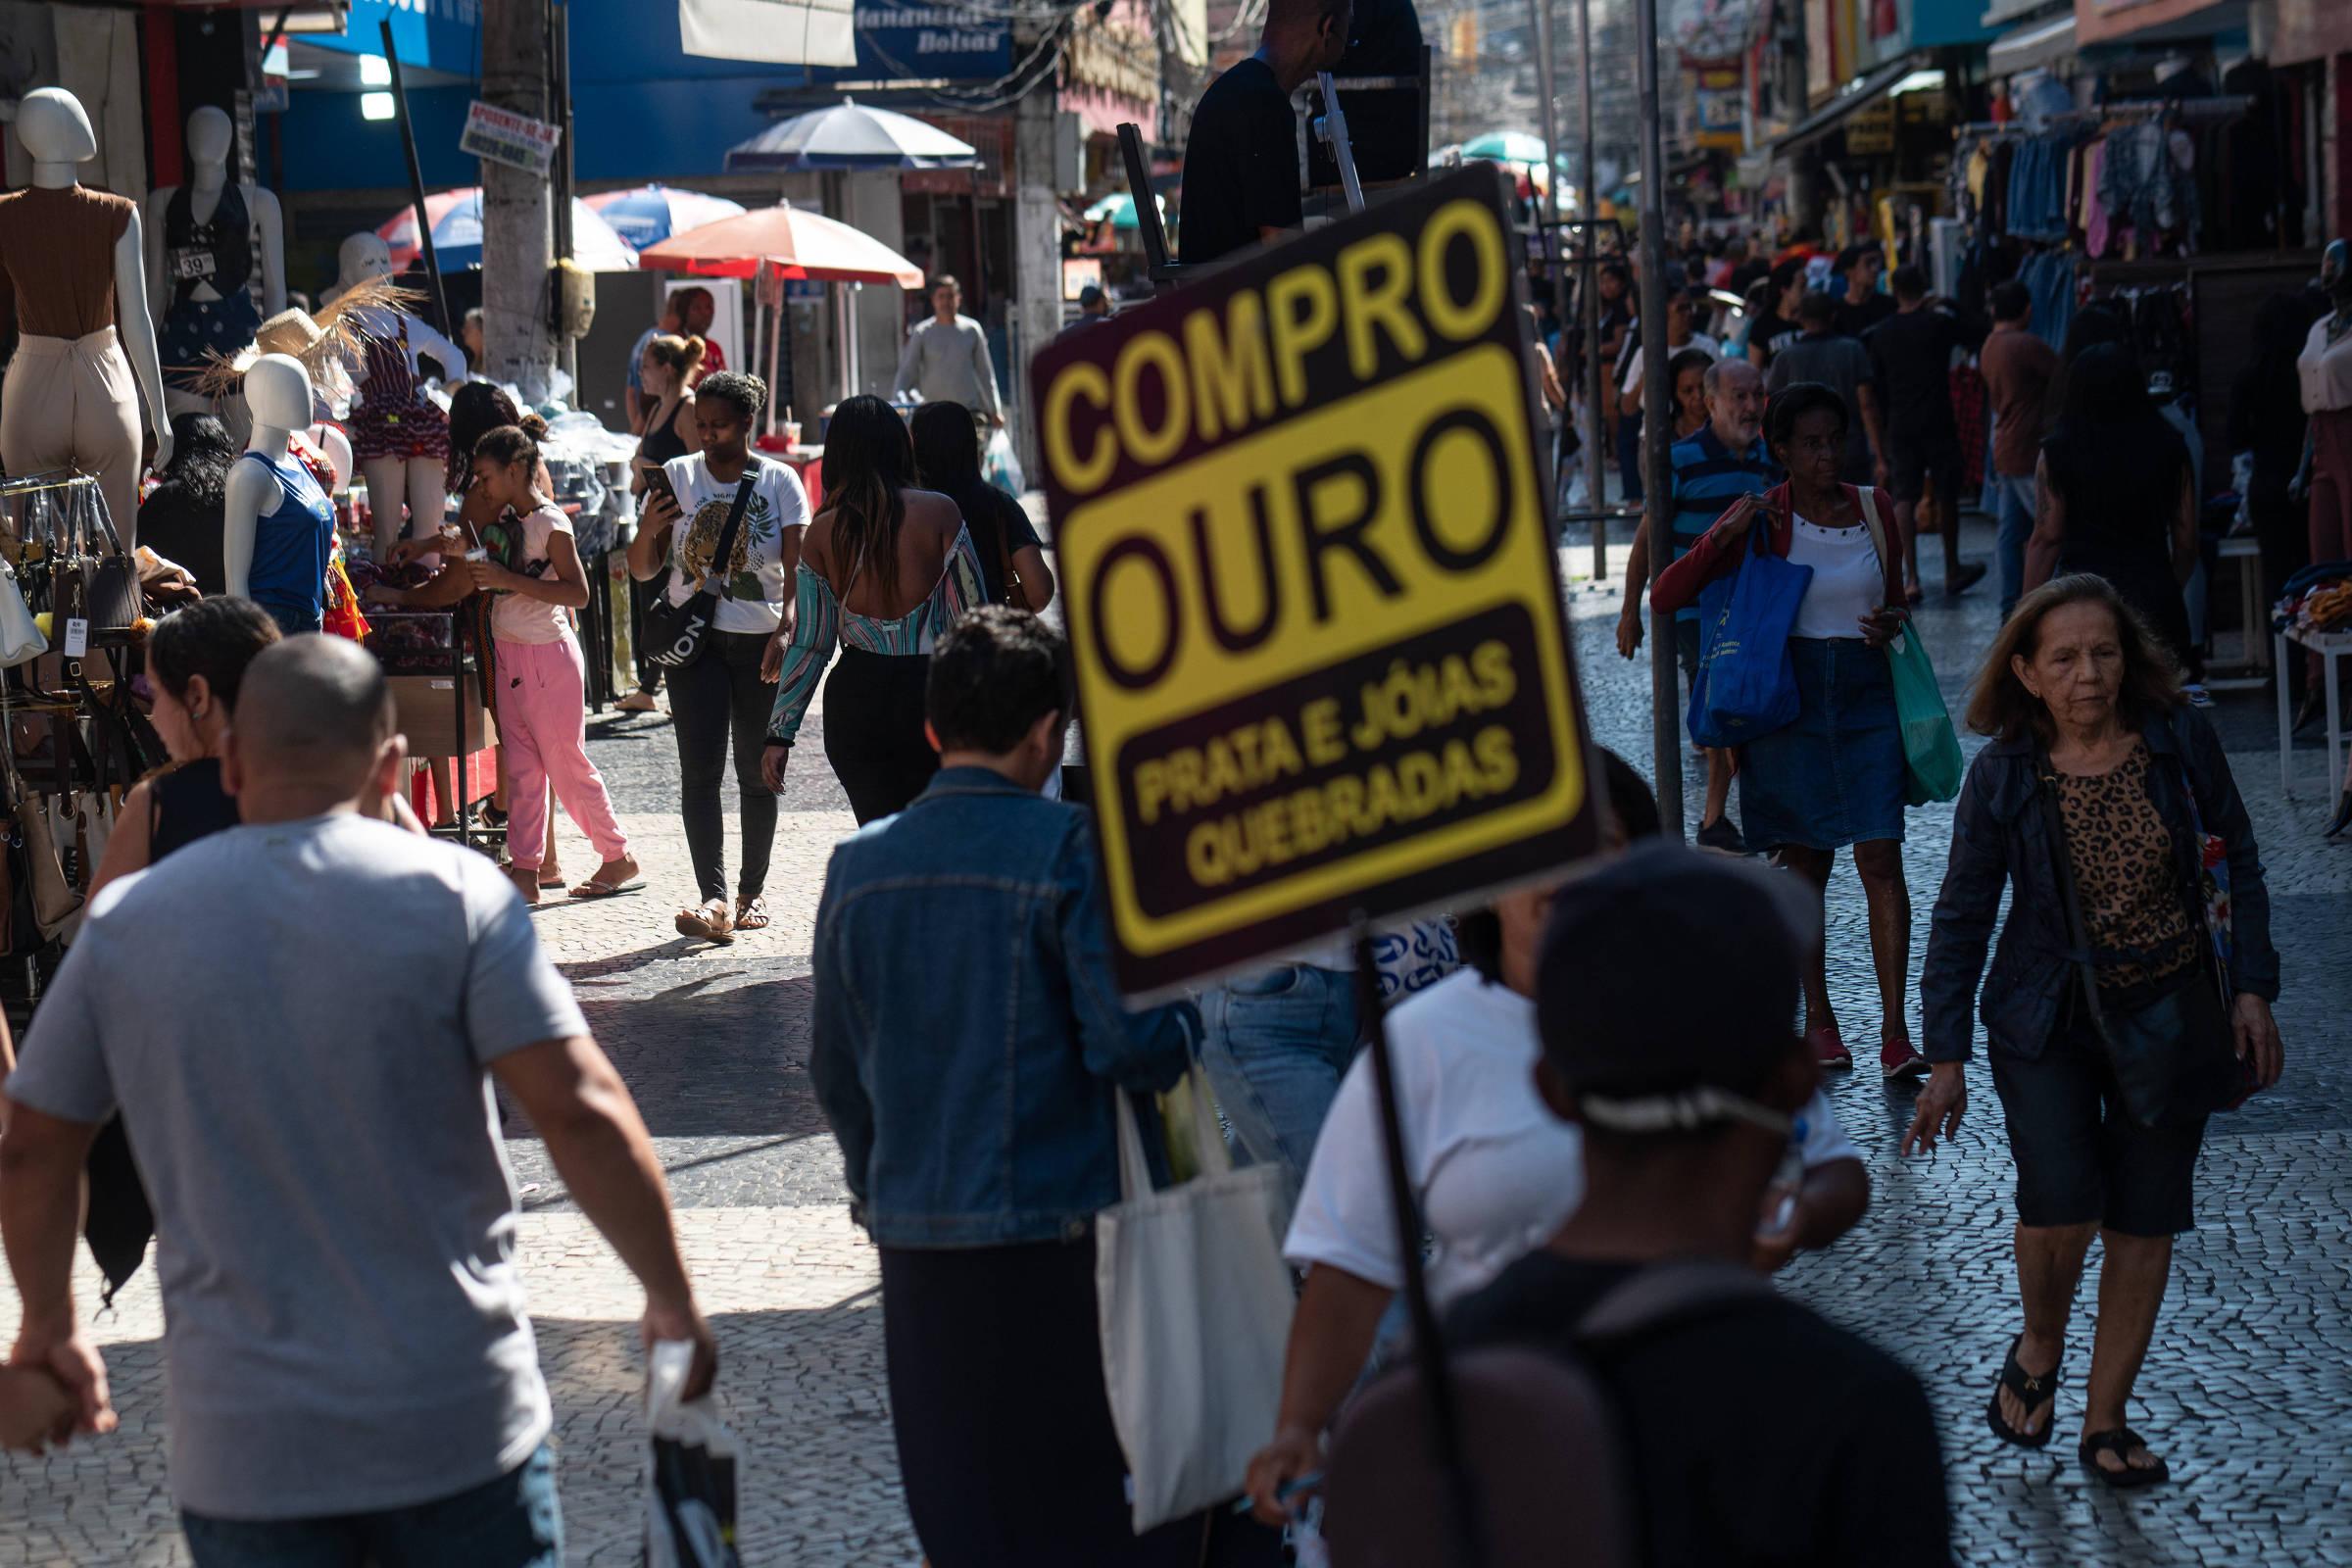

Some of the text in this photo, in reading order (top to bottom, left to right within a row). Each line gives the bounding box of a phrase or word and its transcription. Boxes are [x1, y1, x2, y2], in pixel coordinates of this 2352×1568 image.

[916, 30, 1000, 53] Bolsas
[1045, 201, 1506, 492] COMPRO
[1091, 405, 1514, 689] OURO
[649, 614, 706, 665] HION
[1134, 642, 1516, 821] PRATA E JÓIAS
[1187, 727, 1517, 885] QUEBRADAS
